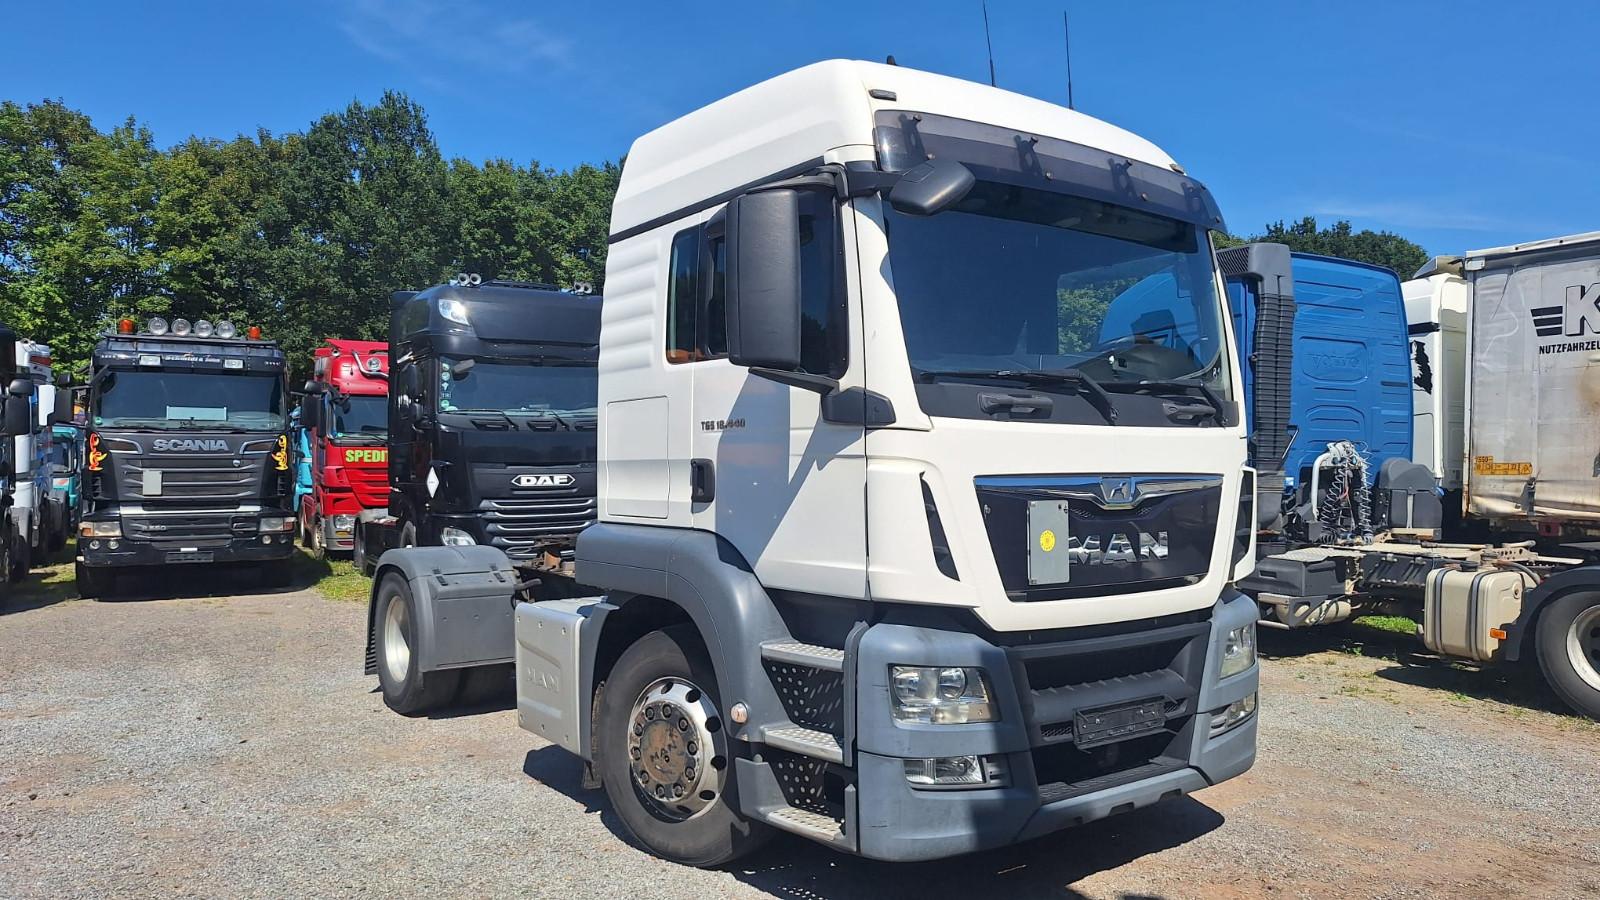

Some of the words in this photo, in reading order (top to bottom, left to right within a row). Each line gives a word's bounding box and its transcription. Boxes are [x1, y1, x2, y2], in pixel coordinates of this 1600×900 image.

[153, 439, 230, 452] SCANIA
[520, 475, 568, 486] DAF
[1068, 531, 1169, 566] MAN
